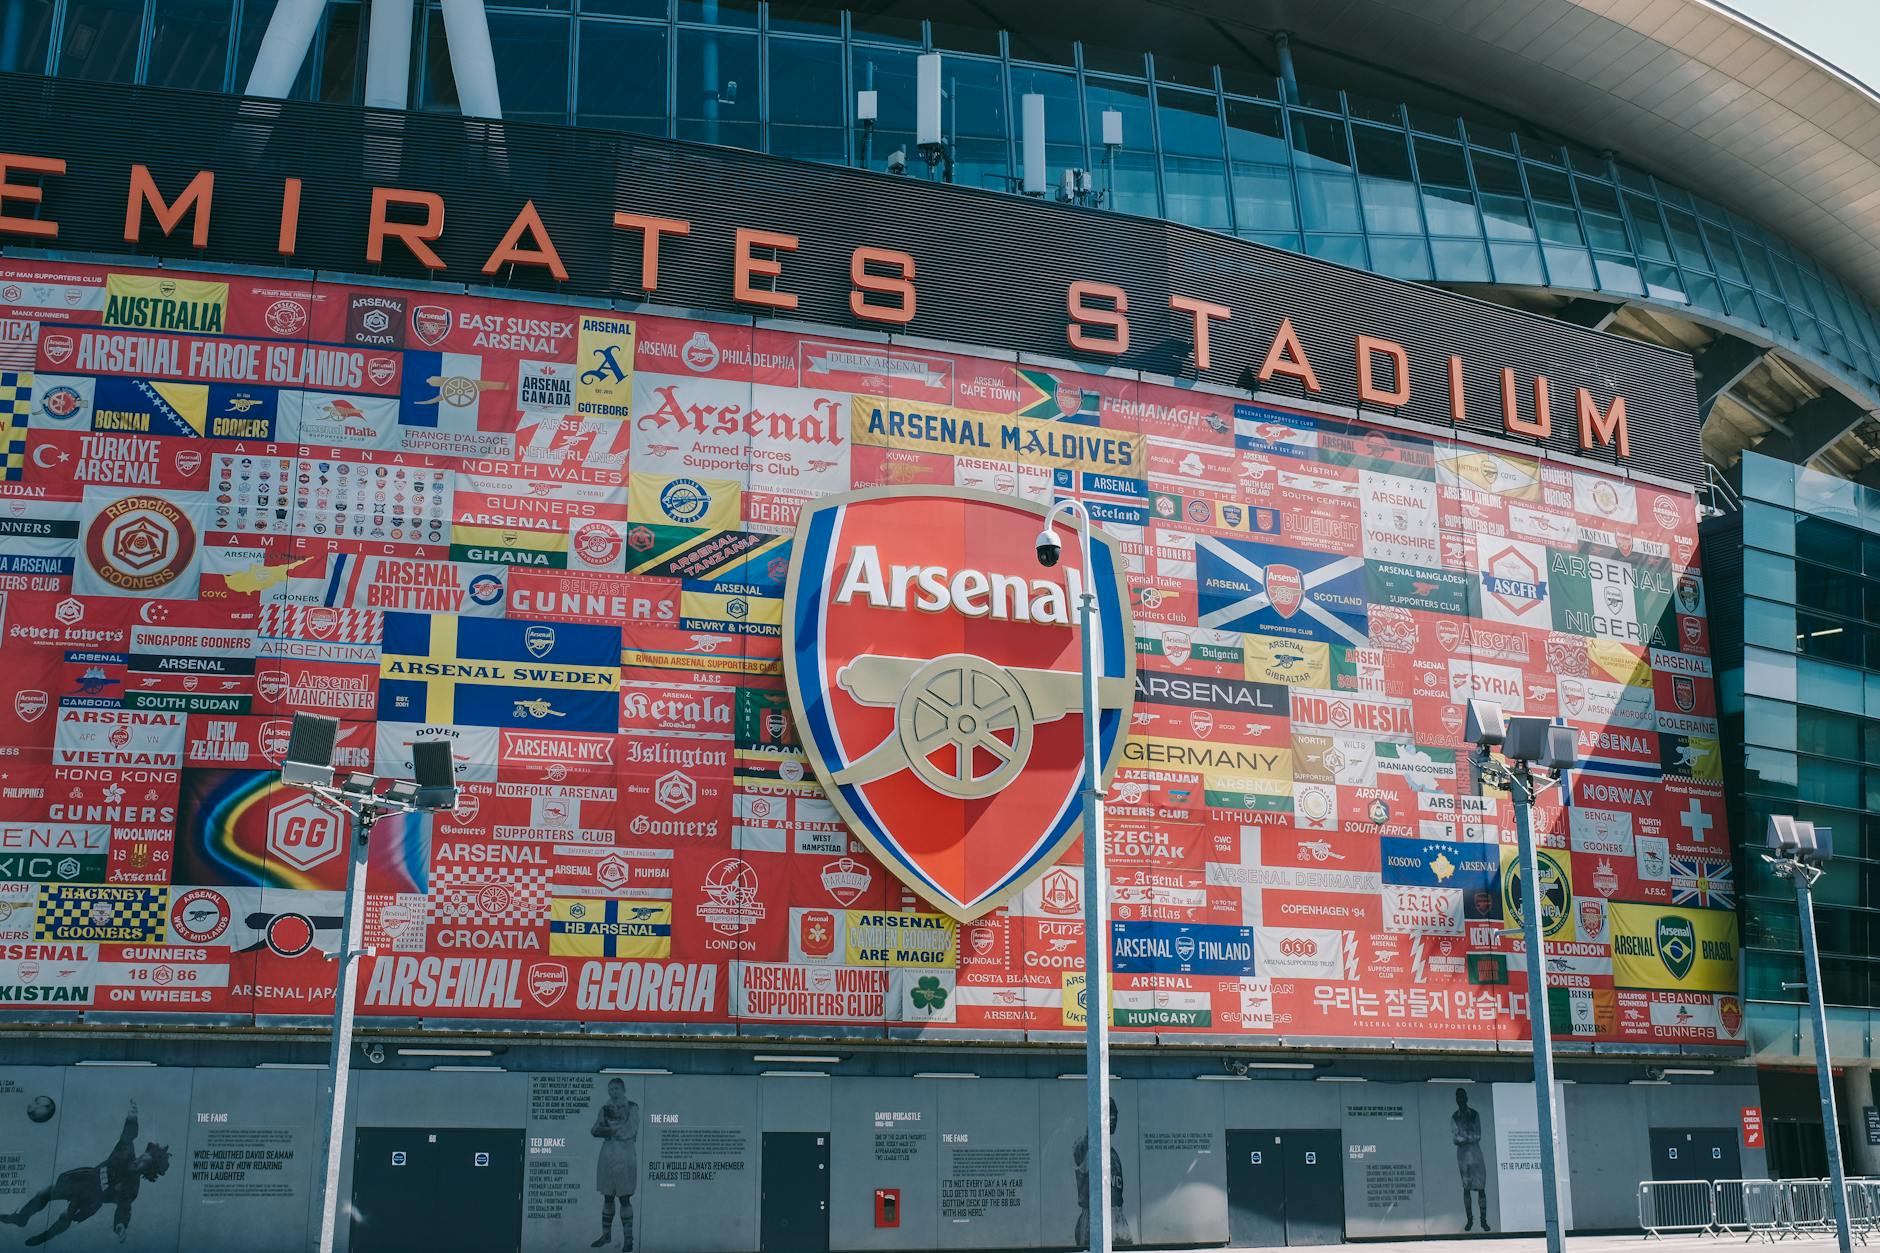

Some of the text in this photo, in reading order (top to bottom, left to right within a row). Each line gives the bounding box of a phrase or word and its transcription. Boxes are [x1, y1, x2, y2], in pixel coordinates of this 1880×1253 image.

[0, 154, 1629, 457] EMIRATES STADIUM
[105, 295, 224, 332] AUSTRALIA
[352, 298, 402, 313] ARSENAL
[34, 311, 69, 319] GUNNERS
[460, 314, 573, 338] EAST SUSSEX
[583, 319, 631, 335] ARSENAL
[355, 333, 395, 344] QATAR
[473, 333, 559, 354] ARSENAL
[76, 333, 364, 389] ARSENAL FAROE ISLANDS
[638, 340, 795, 370] ARSENAL PHILADELPHIA
[522, 377, 571, 392] ARSENAL
[960, 384, 1021, 402] CAPE TOWN
[522, 390, 571, 406] CANADA
[578, 401, 629, 416] GÖTEBORG
[638, 384, 844, 446] Arsenal
[1103, 396, 1200, 423] FERMANAGH
[95, 409, 150, 431] BOSNIAN
[213, 417, 269, 438] GOONERS
[405, 429, 508, 445] FRANCE D'ALSACE
[868, 408, 1133, 466] ARSENAL MALDIVES
[79, 432, 161, 463] TÜRKİYE
[401, 439, 510, 456] SUPPORTERS CLUB
[692, 441, 791, 462] Armed Forces
[74, 461, 160, 484] ARSENAL
[462, 460, 622, 484] NORTH WALES
[683, 454, 799, 476] Supporters Club
[956, 458, 1052, 478] ARSENAL DELHI
[1299, 464, 1339, 477] AUSTRIA
[1093, 477, 1137, 494] ARSENAL
[105, 497, 180, 523] REDaction
[487, 497, 596, 515] GUNNERS
[1092, 503, 1140, 522] Iceland
[460, 513, 562, 530] ARSENAL
[1368, 531, 1435, 549] YORKSHIRE
[467, 549, 549, 565] GHANA
[100, 565, 176, 590] GOONERS
[374, 560, 461, 588] ARSENAL
[1378, 565, 1468, 584] ARSENAL BANGLADESH
[1552, 553, 1670, 594] ARSENAL
[201, 590, 227, 598] COYG
[833, 545, 1084, 626] Arsenal
[1206, 579, 1251, 592] ARSENAL
[1493, 578, 1537, 598] ASCFR
[273, 593, 319, 603] GOONERS
[367, 584, 465, 612] BRITTANY
[512, 588, 674, 620] GUNNERS
[1314, 593, 1362, 606] SCOTLAND
[9, 624, 124, 643] seven towers
[1565, 609, 1666, 647] NIGERIA
[137, 634, 251, 649] SINGAPORE GOONERS
[70, 652, 122, 662] ARSENAL
[159, 659, 225, 671] ARSENAL
[636, 655, 777, 672] RWANDA ARSENAL SUPPORTERS CLUB
[389, 661, 613, 684] ARSENAL SWEDEN
[1265, 668, 1310, 683] GIBRALTAR
[1135, 678, 1273, 707] ARSENAL
[1471, 676, 1520, 696] SYRIA
[62, 699, 121, 708] CAMBODIA
[137, 696, 239, 710] SOUTH SUDAN
[623, 692, 730, 724] Kerala
[63, 711, 180, 726] ARSENAL
[1587, 705, 1652, 720] ARSENAL MOROCCO
[207, 721, 237, 740] NEW
[1659, 717, 1715, 733] COLERAINE
[61, 751, 176, 766] VIETNAM
[190, 740, 250, 761] ZEALAND
[627, 741, 726, 768] Islington
[1124, 743, 1279, 771] GERMANY
[55, 769, 177, 783] HONG KONG
[1377, 762, 1453, 774] IRANIAN GOONERS
[3, 787, 44, 799] PHILIPPINES
[498, 784, 615, 800] NORFOLK ARSENAL
[1584, 785, 1653, 805] NORWAY
[50, 804, 175, 822] GUNNERS
[1212, 811, 1288, 825] LITHUANIA
[629, 815, 718, 837] Gooners
[743, 819, 838, 831] THE ARSENAL
[114, 827, 172, 841] WOOLWICH
[495, 827, 613, 842] SUPPORTERS CLUB
[436, 844, 548, 864] ARSENAL
[109, 868, 167, 882] Arsenal
[555, 866, 669, 878] ARSENAL MUMBAI
[60, 887, 146, 902] HACKNEY
[1281, 903, 1348, 916] COPENHAGEN
[1393, 915, 1454, 927] GUNNERS
[55, 926, 143, 939] GOONERS
[437, 930, 540, 949] CROATIA
[705, 940, 755, 950] LONDON
[1115, 937, 1250, 961] ARSENAL FINLAND
[1557, 944, 1605, 956] LONDON
[1614, 935, 1733, 961] ARSENAL BRASIL
[122, 947, 207, 961] GUNNERS
[364, 956, 718, 1011] ARSENAL GEORGIA
[744, 966, 889, 992] ARSENAL WOMEN
[110, 988, 212, 1002] ON WHEELS
[748, 991, 883, 1016] SUPPORTERS CLUB
[1314, 985, 1380, 1016] 우리는
[1385, 989, 1449, 1018] 잠들지
[1651, 992, 1710, 1004] LEBANON
[1128, 1012, 1196, 1024] HUNGARY
[1654, 1026, 1714, 1038] GUNNERS
[197, 1113, 227, 1122] THE FANS
[531, 1139, 565, 1147] TED DRAKE
